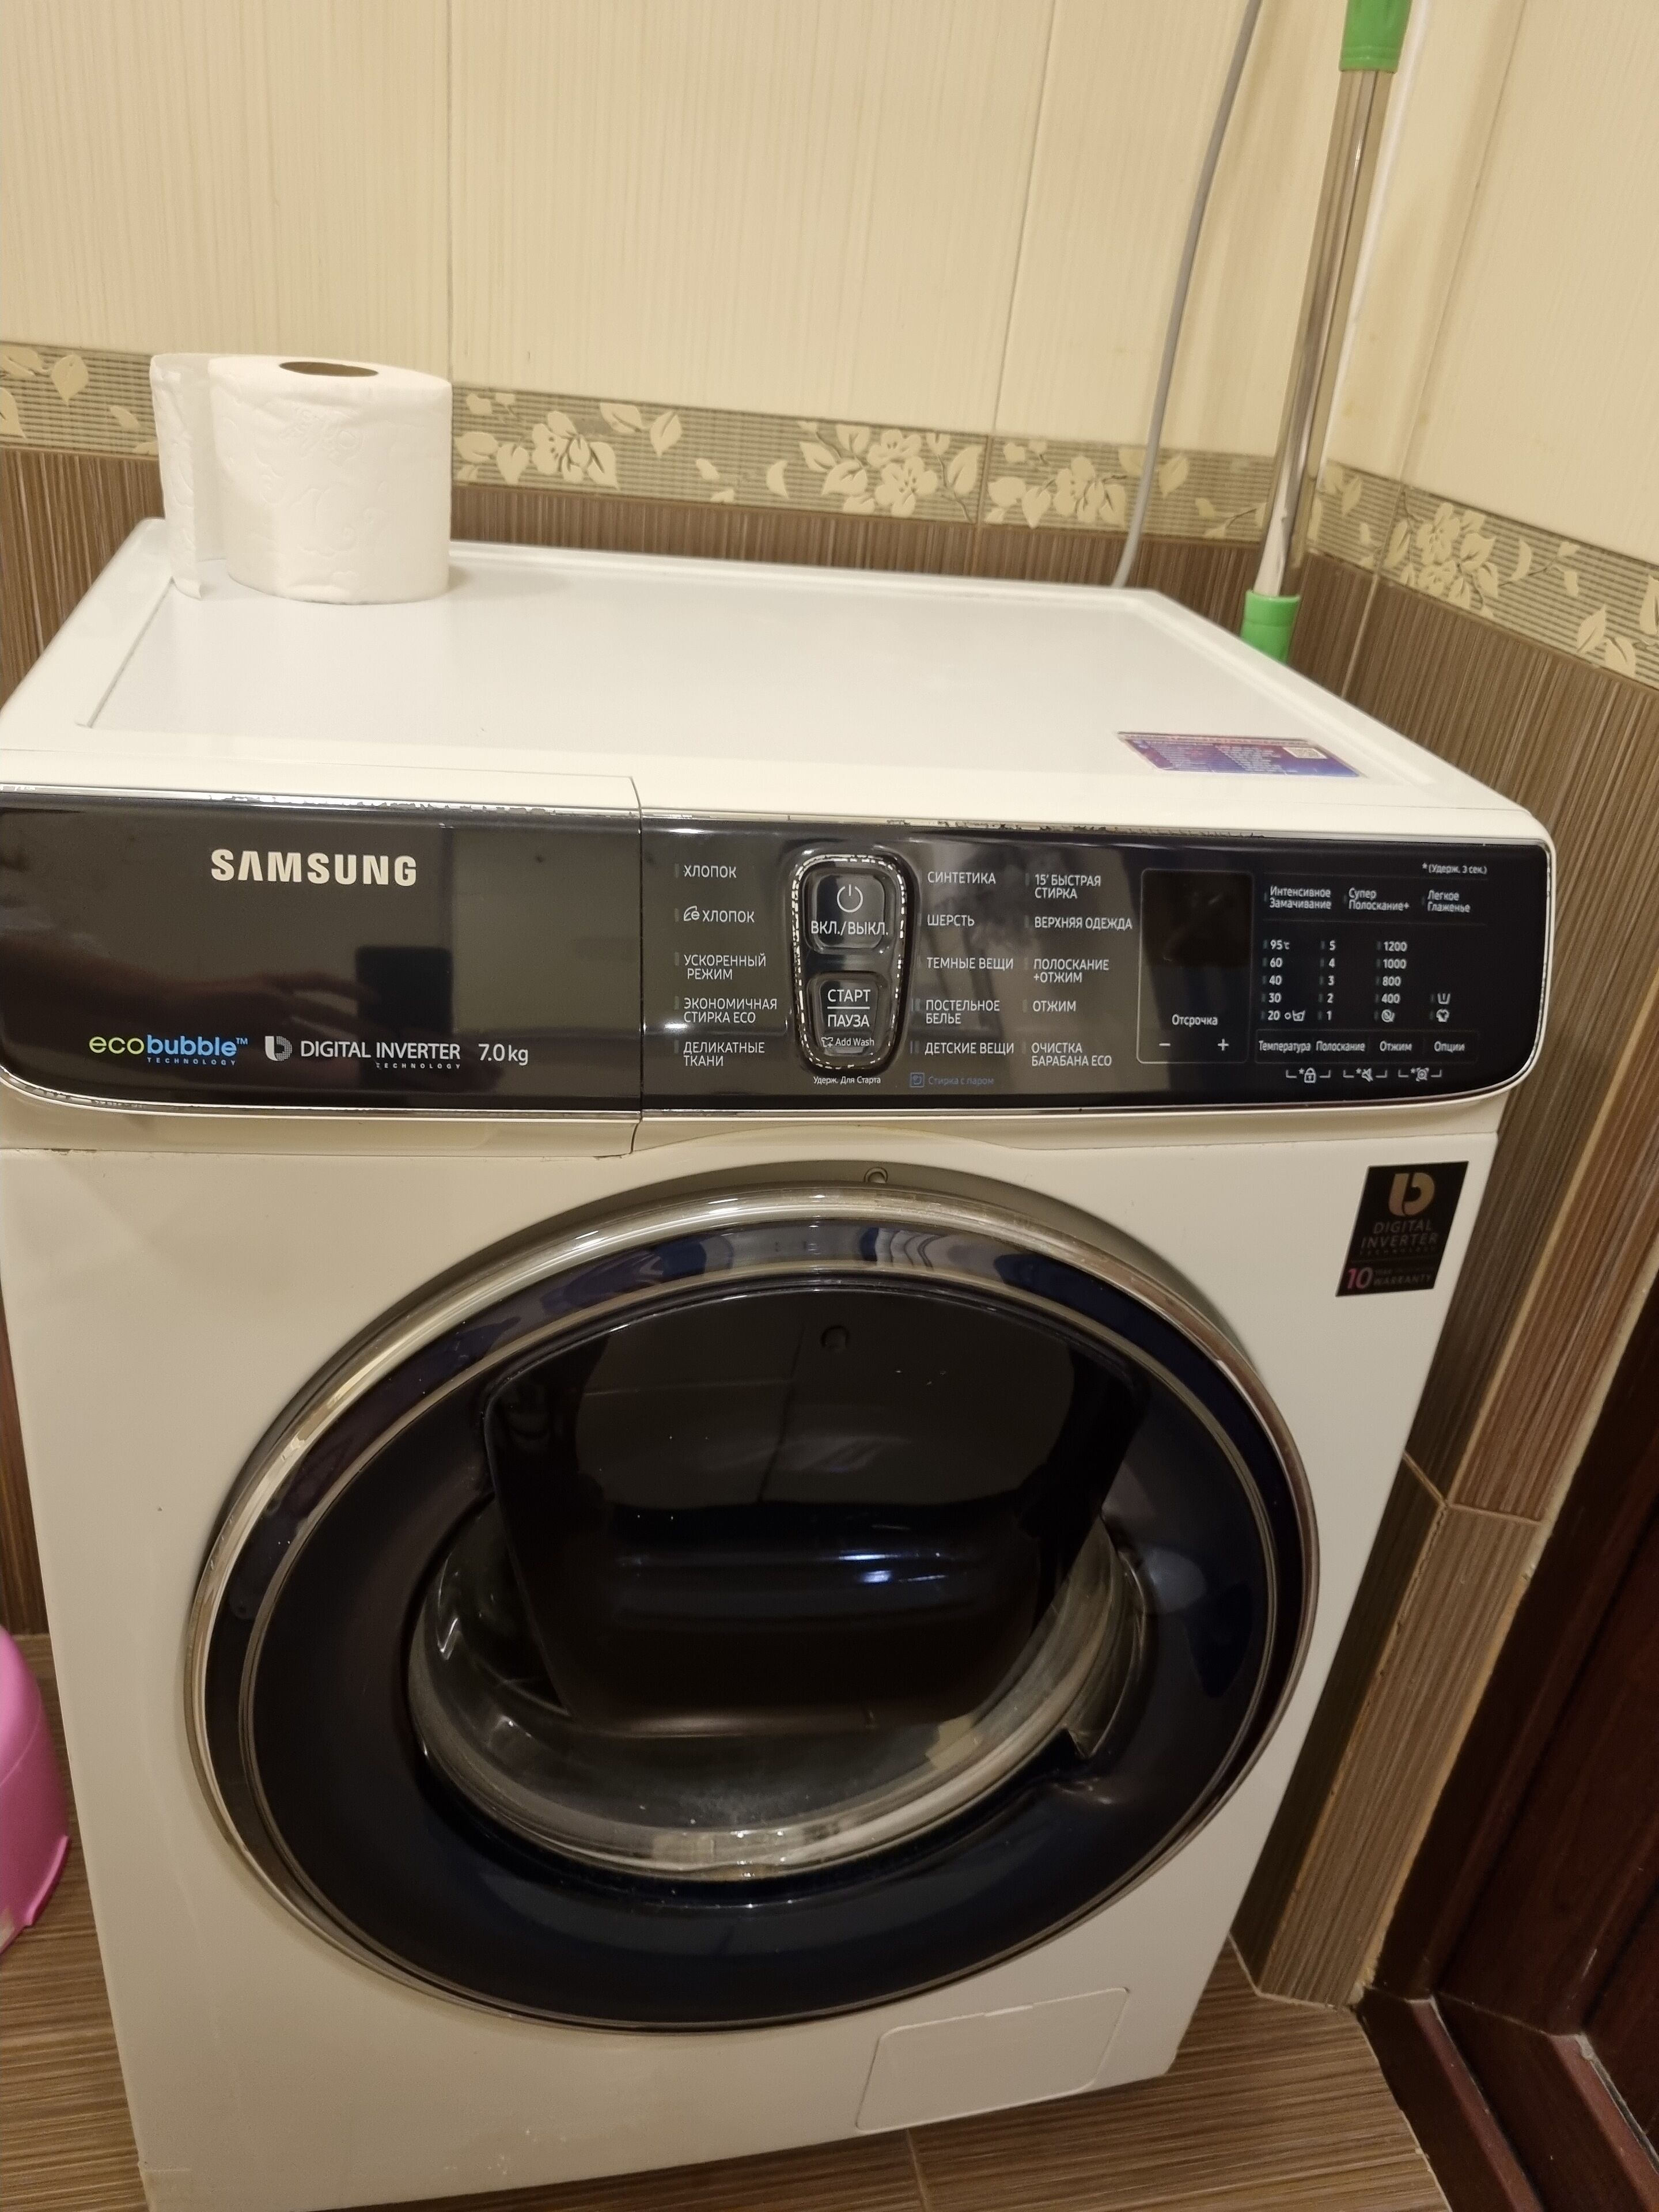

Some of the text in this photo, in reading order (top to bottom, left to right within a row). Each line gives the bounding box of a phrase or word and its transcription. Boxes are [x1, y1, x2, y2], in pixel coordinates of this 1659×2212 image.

[211, 849, 417, 887] SAMSUNG
[683, 865, 737, 878] ХЛОПОК
[927, 872, 996, 884] СИНТЕТИКА
[1051, 875, 1101, 887] БЫСТРАЯ
[1035, 888, 1078, 899] СТИРКА
[1270, 885, 1331, 898] Интенсивное
[1349, 888, 1377, 900] Супер
[1427, 890, 1460, 902] Легкое
[1270, 897, 1332, 910] Замачивание
[1427, 902, 1471, 913] Глаженье
[702, 910, 755, 923] ХЛОПОК
[927, 915, 975, 926] ШЕРСТЬ
[1035, 916, 1132, 930] ВЕРХНЯЯ ОДЕЖДА
[1330, 940, 1336, 950] 5
[1383, 941, 1408, 952] 1200
[684, 953, 767, 967] УСКОРЕННЫЙ
[927, 957, 1014, 971] ТЕМНЫЕ ВЕЩИ
[1033, 959, 1109, 971] ПОЛОСКАНИЕ
[1270, 957, 1283, 968] 60
[1328, 957, 1335, 968] 4
[1383, 959, 1407, 969] 1000
[687, 968, 733, 980] РЕЖИМ
[1269, 975, 1283, 986] 40
[1328, 975, 1335, 986] 3
[1382, 976, 1402, 987] 800
[827, 989, 870, 1002] СТАРТ
[1268, 993, 1282, 1003] 30
[1327, 993, 1334, 1003] 2
[1381, 994, 1401, 1004] 400
[684, 998, 777, 1010] ЭКОНОМИЧНАЯ
[926, 1000, 1000, 1012] ПОСТЕЛЬНОЕ
[1033, 1001, 1076, 1012] ОТЖИМ
[683, 1012, 730, 1024] СТИРКА
[827, 1014, 870, 1028] ПАУЗА
[926, 1013, 961, 1024] БЕЛЬЕ
[1172, 1014, 1218, 1027] Отсрочка
[1267, 1010, 1281, 1021] 20
[1327, 1010, 1332, 1021] 1
[683, 1041, 765, 1055] ДЕЛИКАТНЫЕ
[835, 1037, 875, 1047] Add Wash
[1259, 1040, 1311, 1053] Температура
[1316, 1040, 1366, 1052] Полоскание
[1380, 1041, 1412, 1052] Отжим
[1434, 1041, 1465, 1053] Опции
[300, 1040, 372, 1058] DIGITAL
[376, 1041, 461, 1060] INVERTER
[925, 1042, 1014, 1056] ДЕТСКИЕ ВЕЩИ
[1032, 1043, 1082, 1054] ОЧИСТКА
[147, 1056, 236, 1066] TECHNOLOGY
[684, 1055, 724, 1067] ТКАНИ
[1032, 1055, 1089, 1066] БАРАБАНА
[813, 1075, 881, 1085] Удерж. Для Старта
[928, 1075, 959, 1086] Стирка
[968, 1078, 994, 1086] паром
[1373, 1218, 1433, 1234] DIGITAL
[1361, 1233, 1439, 1249] INVERTER
[1347, 1267, 1373, 1290] 10
